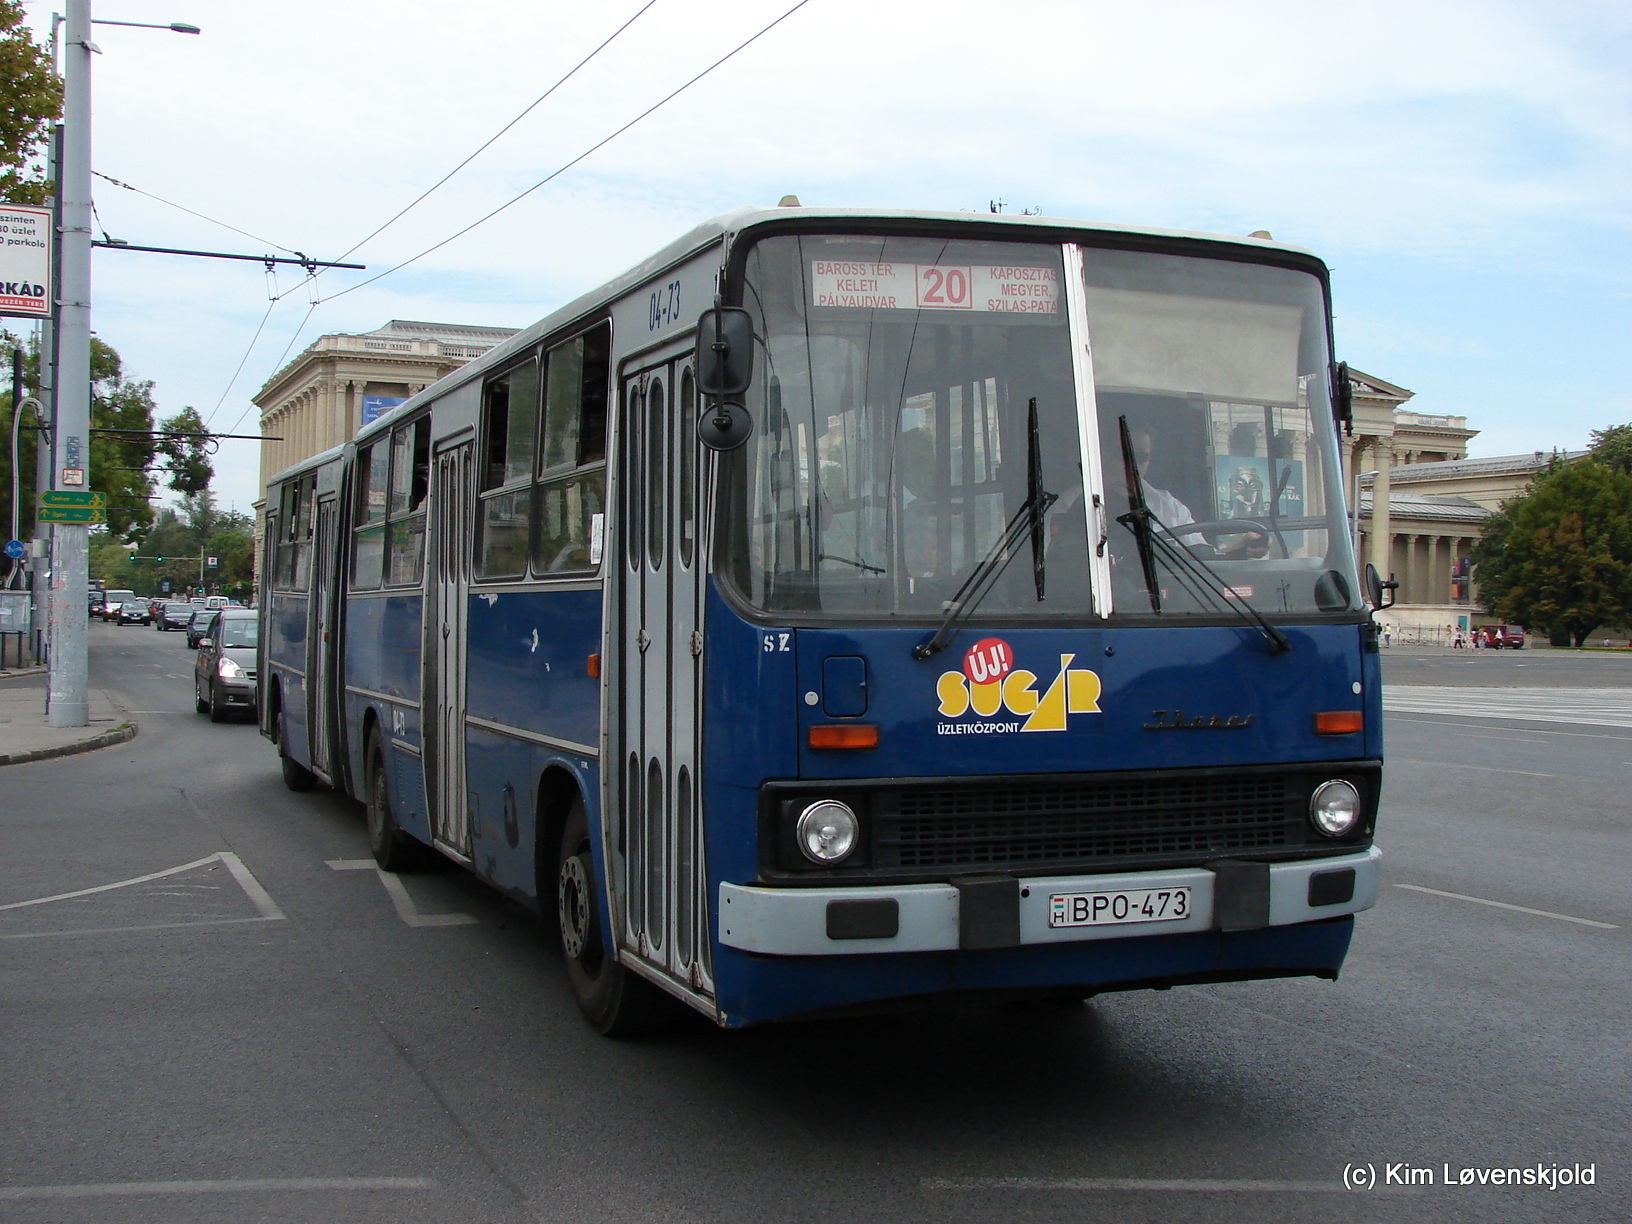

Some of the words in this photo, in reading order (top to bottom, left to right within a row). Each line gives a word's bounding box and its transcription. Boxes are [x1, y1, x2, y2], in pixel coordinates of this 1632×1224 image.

[0, 215, 36, 224] szinten
[12, 226, 36, 235] üzlet
[7, 238, 45, 248] parkoló
[817, 262, 867, 276] BAROSS
[836, 279, 878, 292] KELETI
[923, 268, 966, 304] 20
[1001, 283, 1052, 300] MEGYER,
[649, 279, 681, 332] 04-73
[818, 292, 897, 308] PÁLYAUDVAR
[968, 643, 1009, 683] ÚJ!
[936, 653, 1103, 733] SUGÁR
[937, 720, 1020, 736] ÜZLETKÖZPONT
[1053, 911, 1065, 923] H
[1073, 890, 1187, 923] BPO-473
